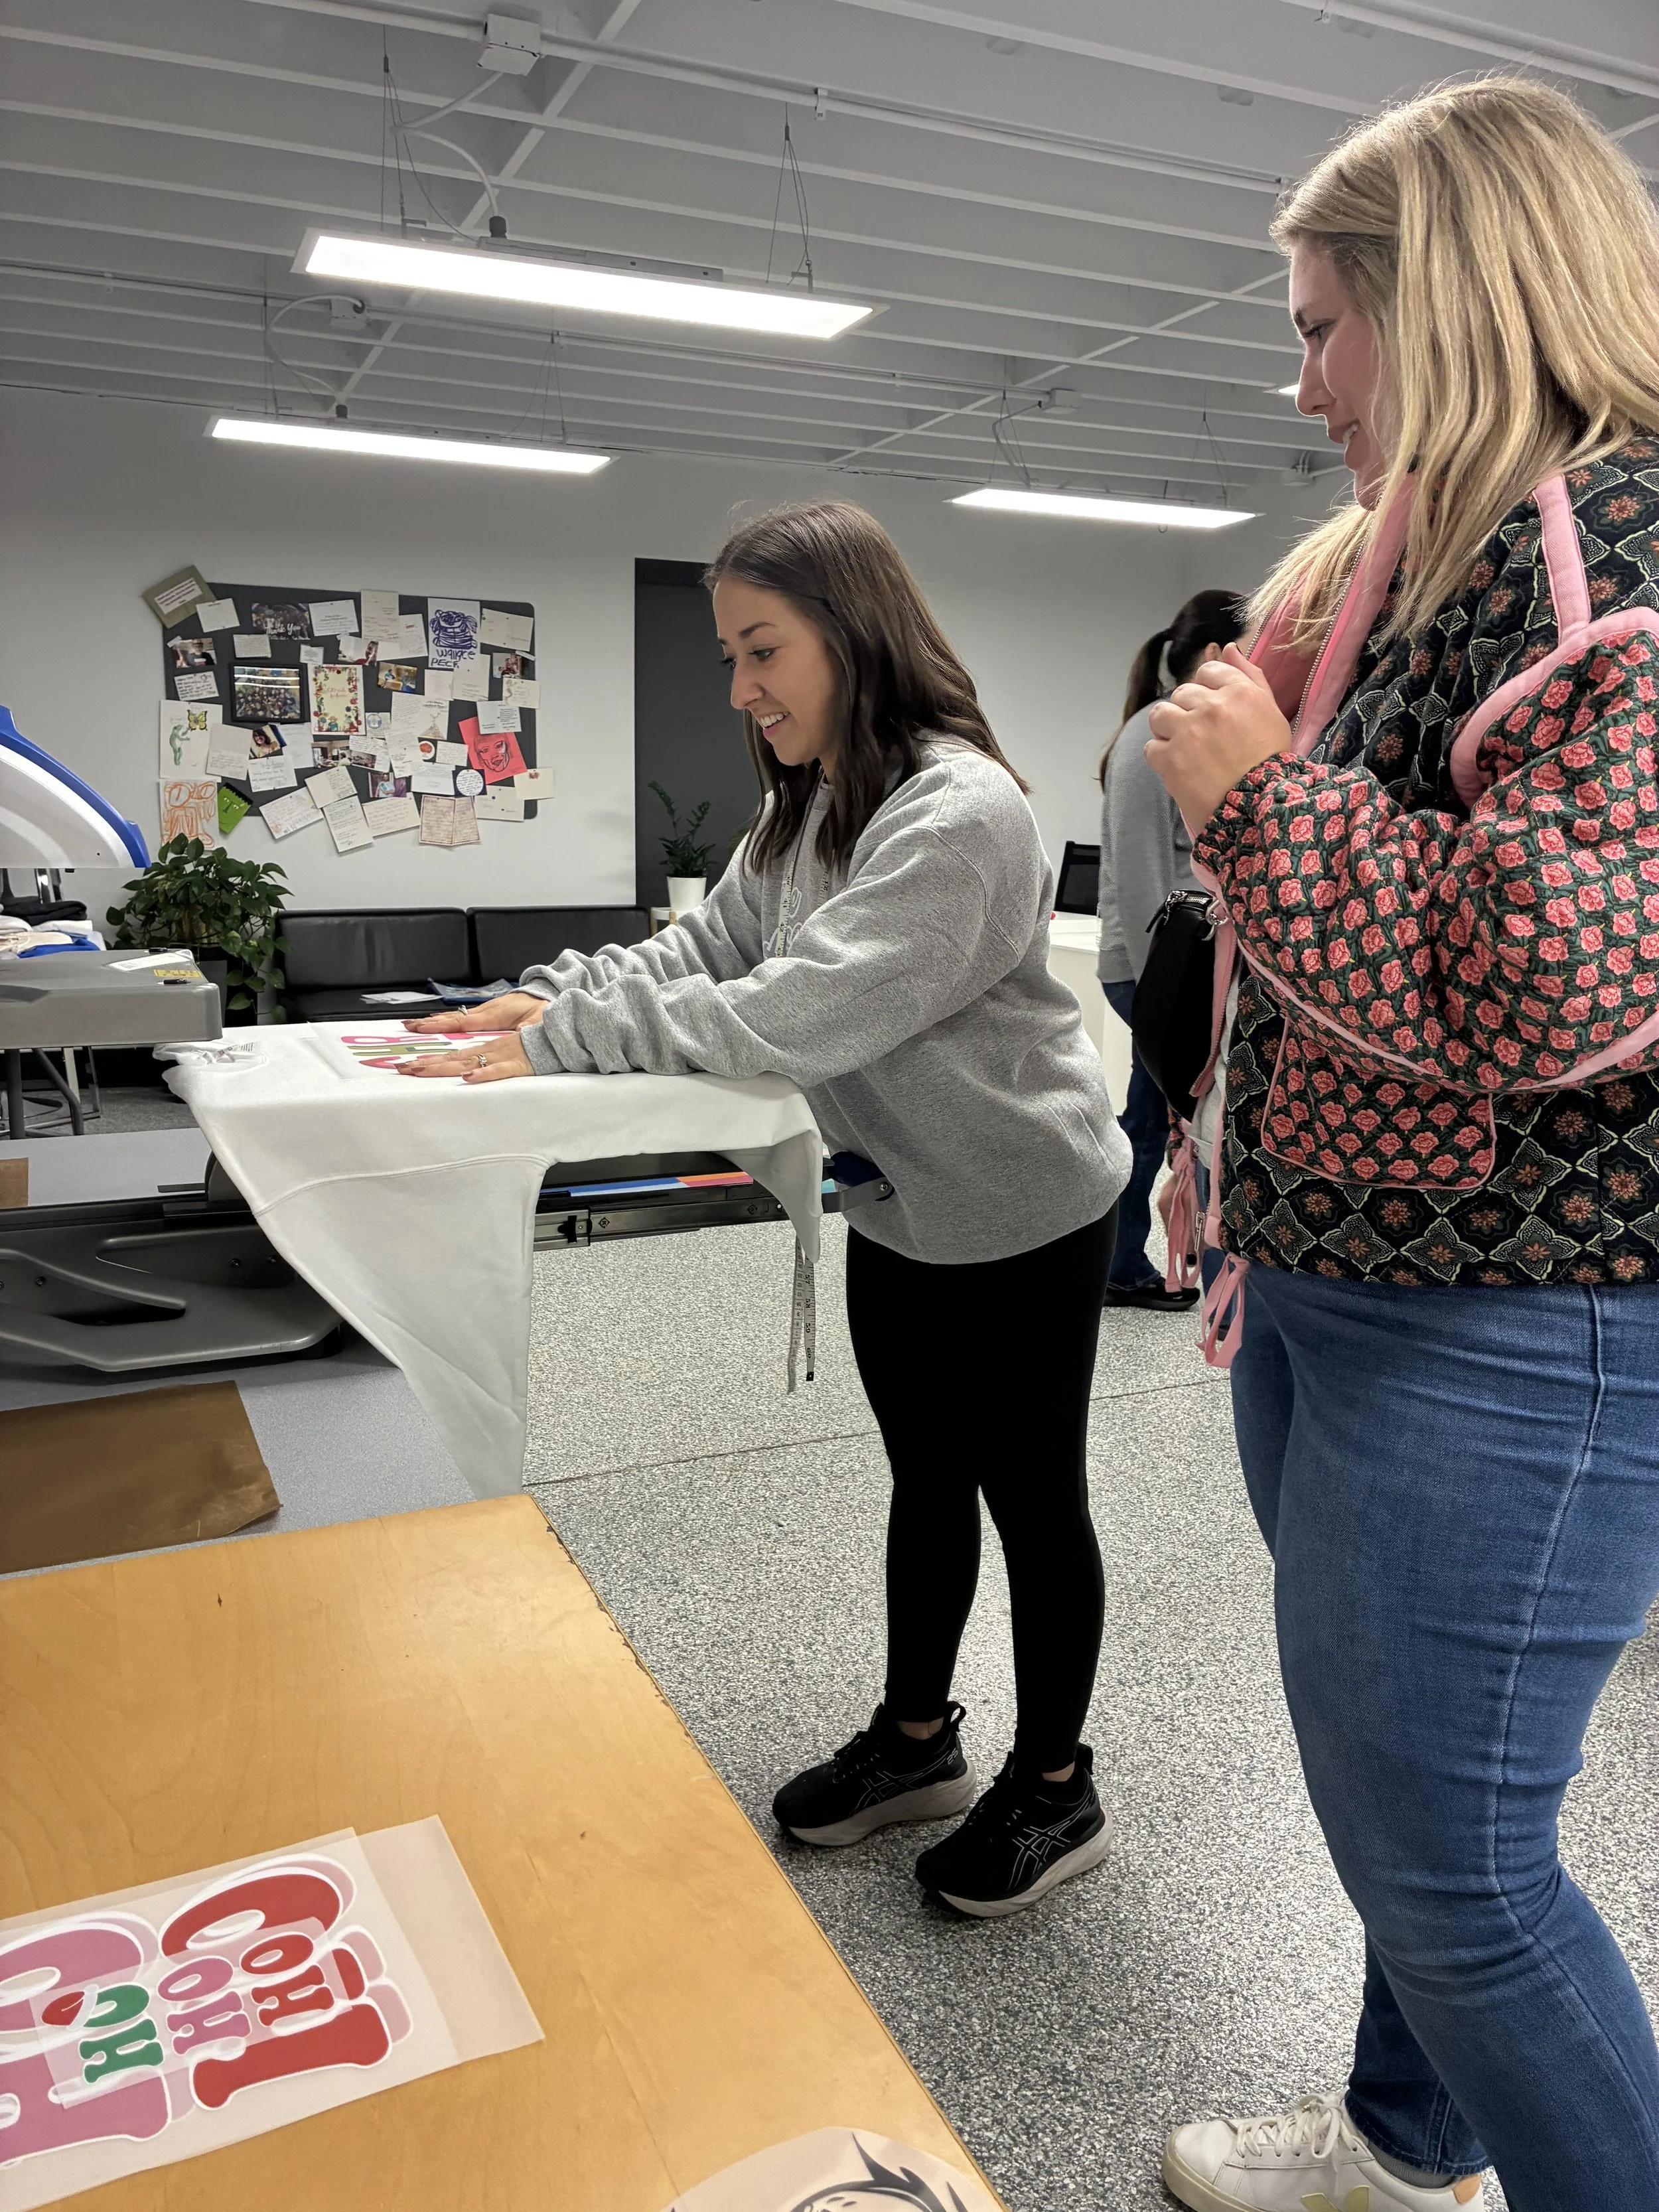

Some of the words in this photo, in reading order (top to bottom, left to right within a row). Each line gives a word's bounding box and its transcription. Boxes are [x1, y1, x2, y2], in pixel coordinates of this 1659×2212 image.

[805, 1274, 810, 1285] 57
[805, 1298, 810, 1309] 58
[805, 1323, 811, 1333] 59
[806, 1348, 812, 1359] 60
[946, 1747, 958, 1765] 25
[240, 1931, 335, 2028] HO
[157, 1955, 252, 2056] HO
[78, 1984, 165, 2085] HO
